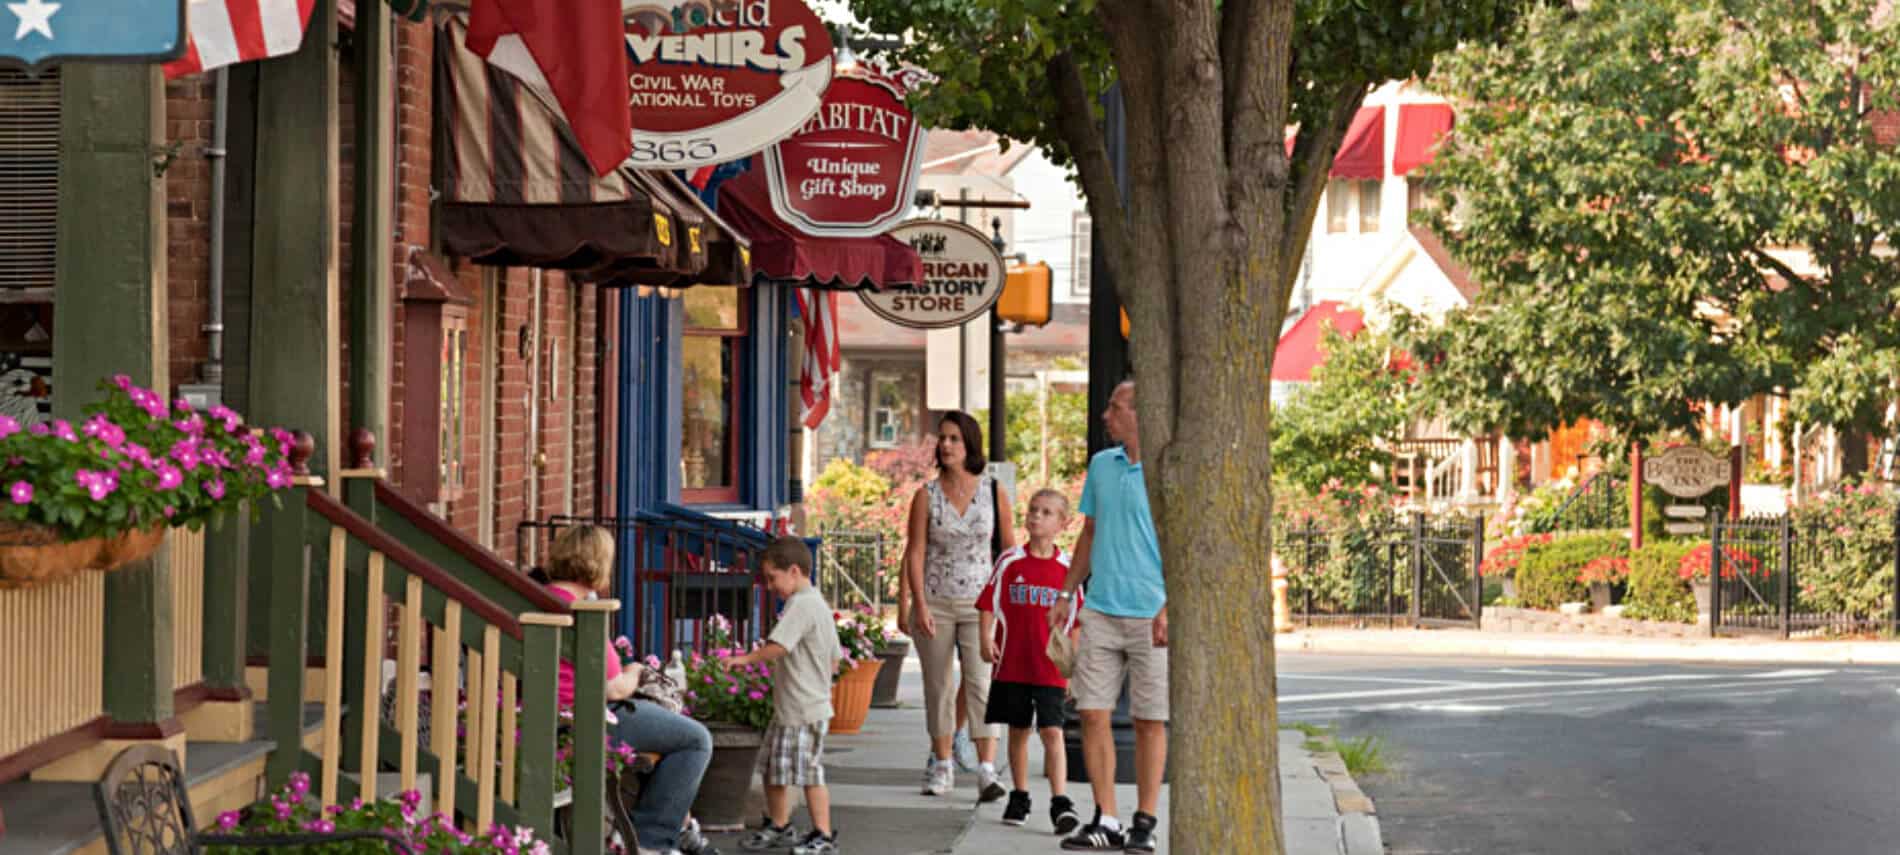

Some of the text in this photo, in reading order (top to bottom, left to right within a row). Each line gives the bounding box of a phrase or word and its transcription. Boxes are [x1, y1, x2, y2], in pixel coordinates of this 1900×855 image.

[629, 73, 725, 91] CIVIL WAR
[709, 91, 757, 107] TOYS
[806, 157, 881, 178] Unique
[800, 176, 887, 201] Gift Shop
[899, 280, 986, 296] STORY
[892, 296, 965, 312] STORE
